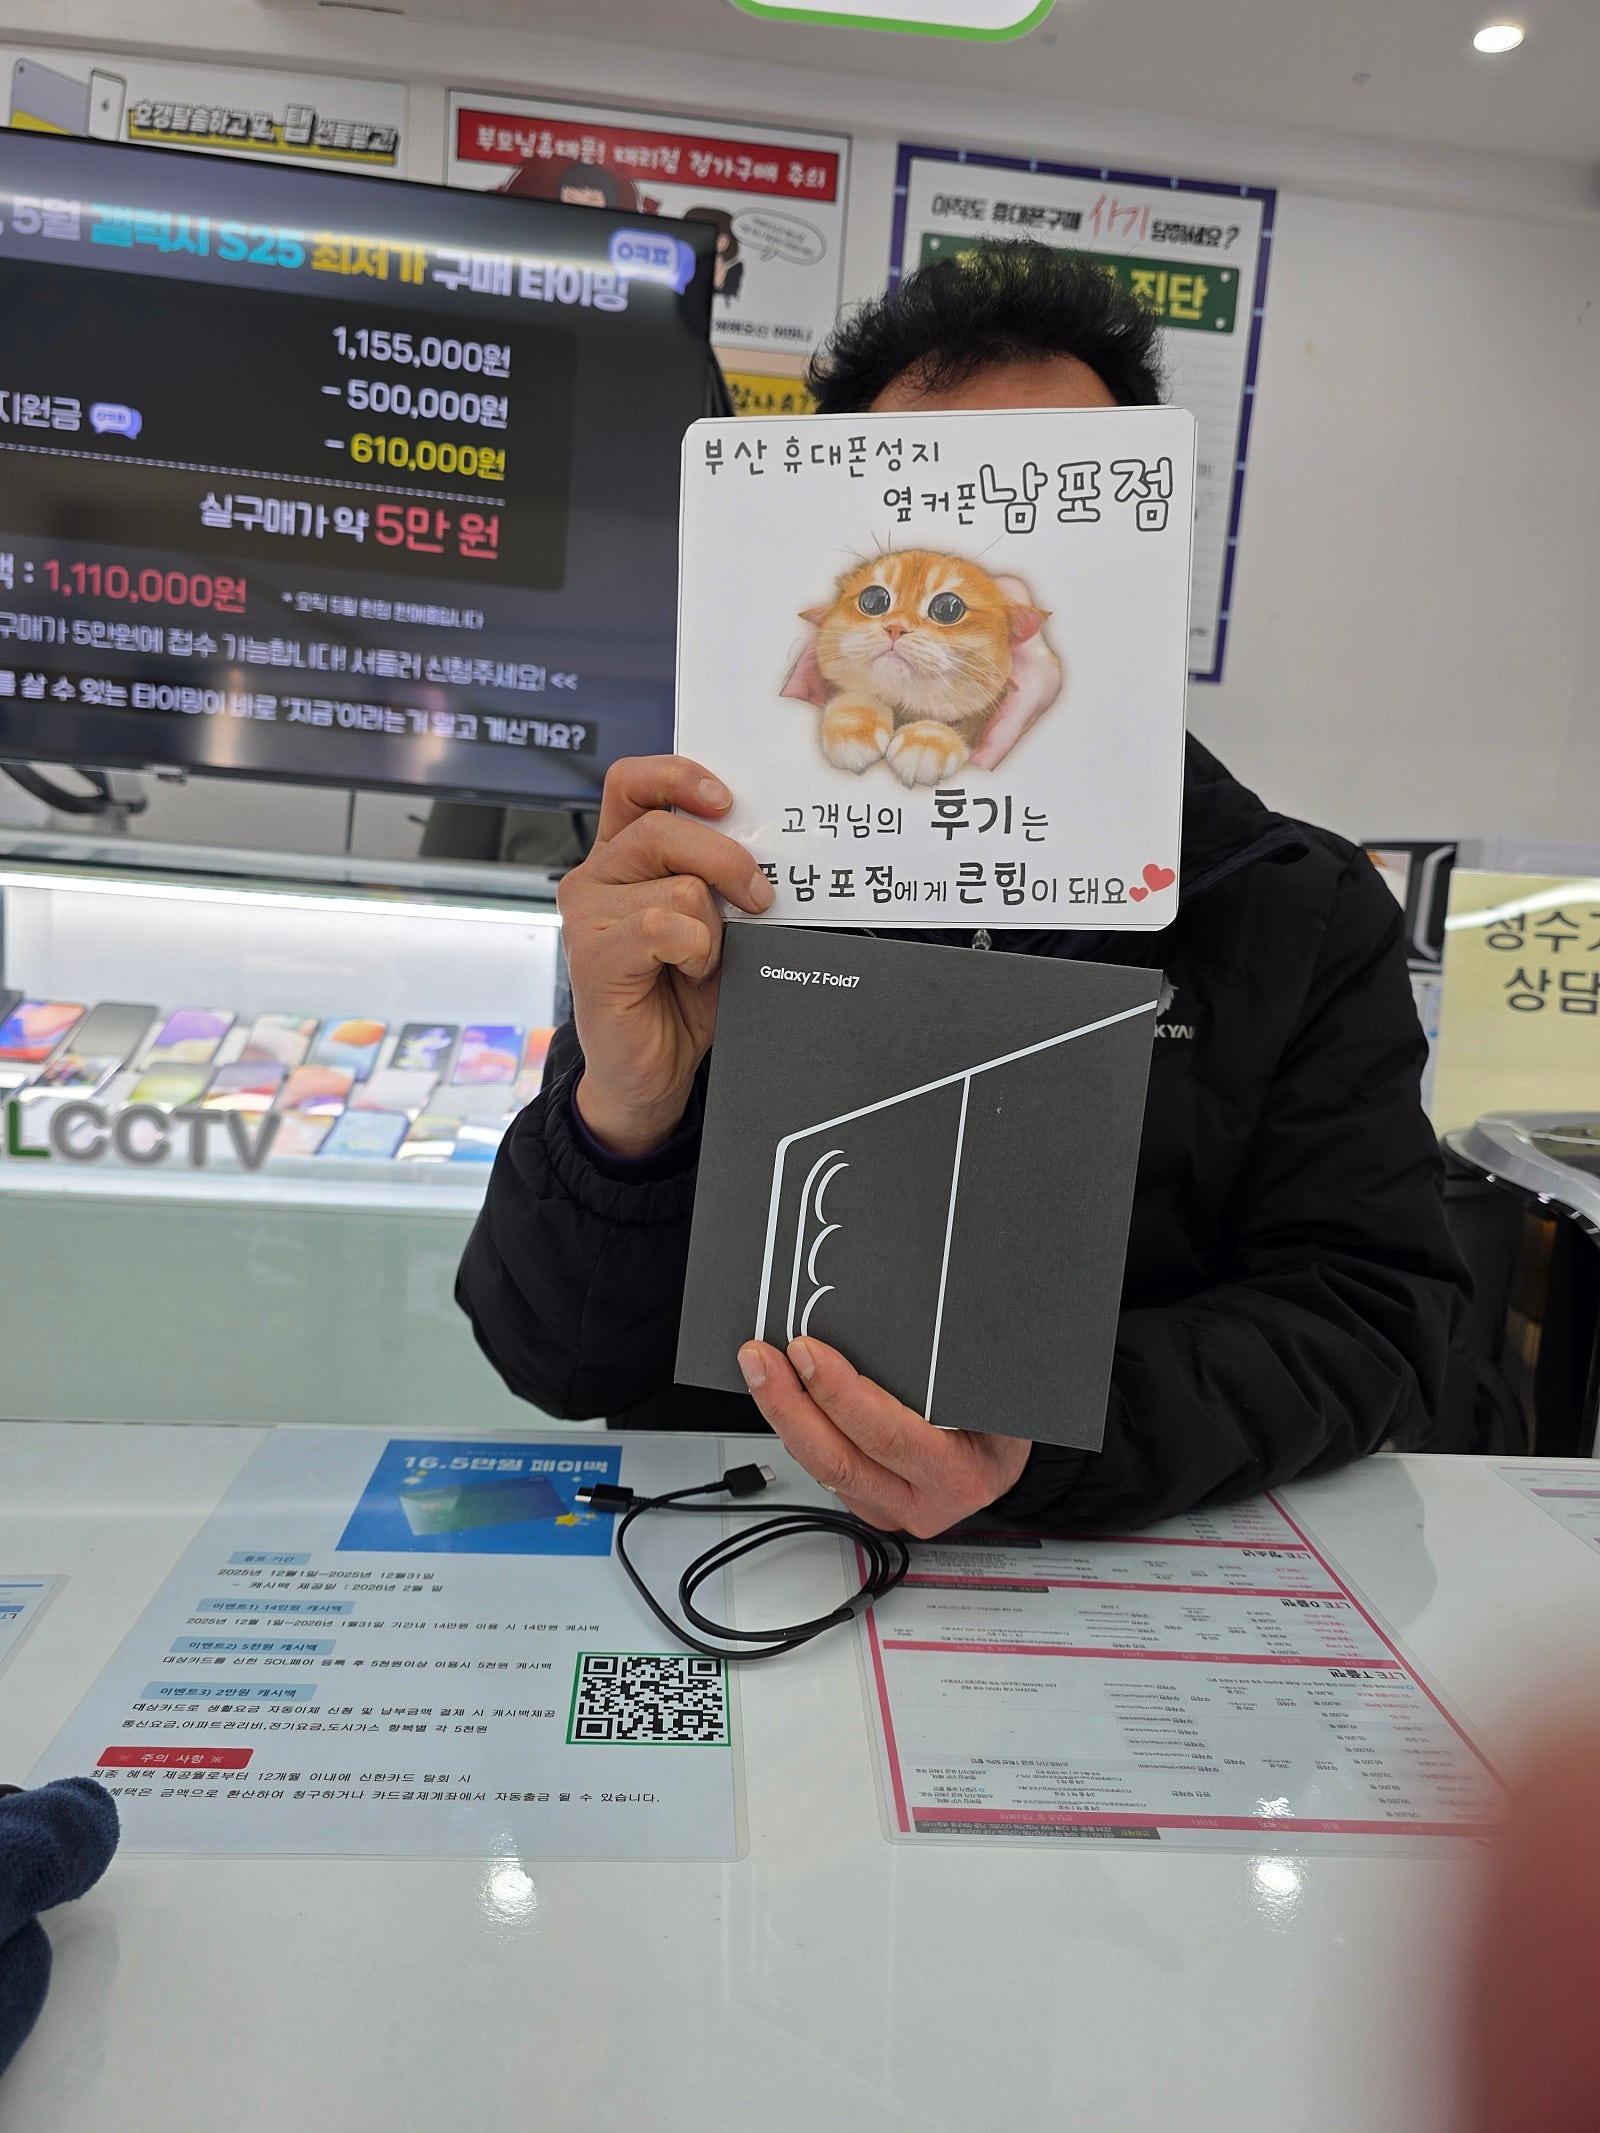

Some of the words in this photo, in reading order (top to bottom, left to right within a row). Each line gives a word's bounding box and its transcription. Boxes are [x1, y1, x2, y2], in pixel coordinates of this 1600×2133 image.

[12, 196, 81, 242] 5월
[89, 202, 210, 257] 갤럭시
[217, 220, 306, 270] S25
[311, 231, 428, 285] 최저가
[433, 247, 512, 296] 구매
[518, 260, 629, 312] 타이밍
[332, 326, 511, 378] 1,155,000원
[346, 378, 509, 429] 500,000원
[350, 432, 506, 481] 610,000원
[704, 439, 768, 476] 부산
[783, 434, 940, 478] 휴대폰성지
[882, 481, 976, 526] 옆커폰
[978, 455, 1174, 534] 남포점
[199, 491, 329, 540] 실구매가
[331, 506, 369, 544] 약
[374, 503, 449, 554] 5만
[457, 513, 499, 560] 원
[43, 558, 248, 614] 1,110,000원
[71, 619, 164, 655] 5만원에
[167, 627, 218, 660] 접수
[51, 674, 77, 702] 수
[78, 677, 128, 708] 있는
[130, 681, 225, 717] 타이밍이
[780, 802, 903, 839] 고객님의
[930, 788, 1049, 842] 후기는
[1067, 874, 1128, 906] 돼요
[760, 965, 812, 986] Galaxy
[811, 971, 821, 984] Z
[822, 972, 861, 988] Fold7
[217, 1568, 262, 1577] 2025년
[1322, 1601, 1351, 1609] LTE
[241, 1643, 274, 1651] 5천원
[280, 1643, 318, 1652] 캐시백
[515, 1662, 552, 1670] 캐시백
[1375, 1671, 1406, 1680] LTE
[215, 1689, 251, 1697] 2만원
[257, 1689, 297, 1698] 캐시백
[267, 1706, 321, 1715] 자동이체
[440, 1708, 465, 1717] 결제
[454, 1725, 488, 1733] 5천원
[140, 1754, 170, 1763] 주의
[176, 1754, 205, 1764] 사항
[257, 1772, 301, 1781] 12개월
[309, 1773, 351, 1782] 이내에
[360, 1773, 415, 1782] 신한카드
[161, 1789, 219, 1798] 금액으로
[227, 1790, 284, 1799] 환산하여
[601, 1793, 661, 1803] 있습니다.
